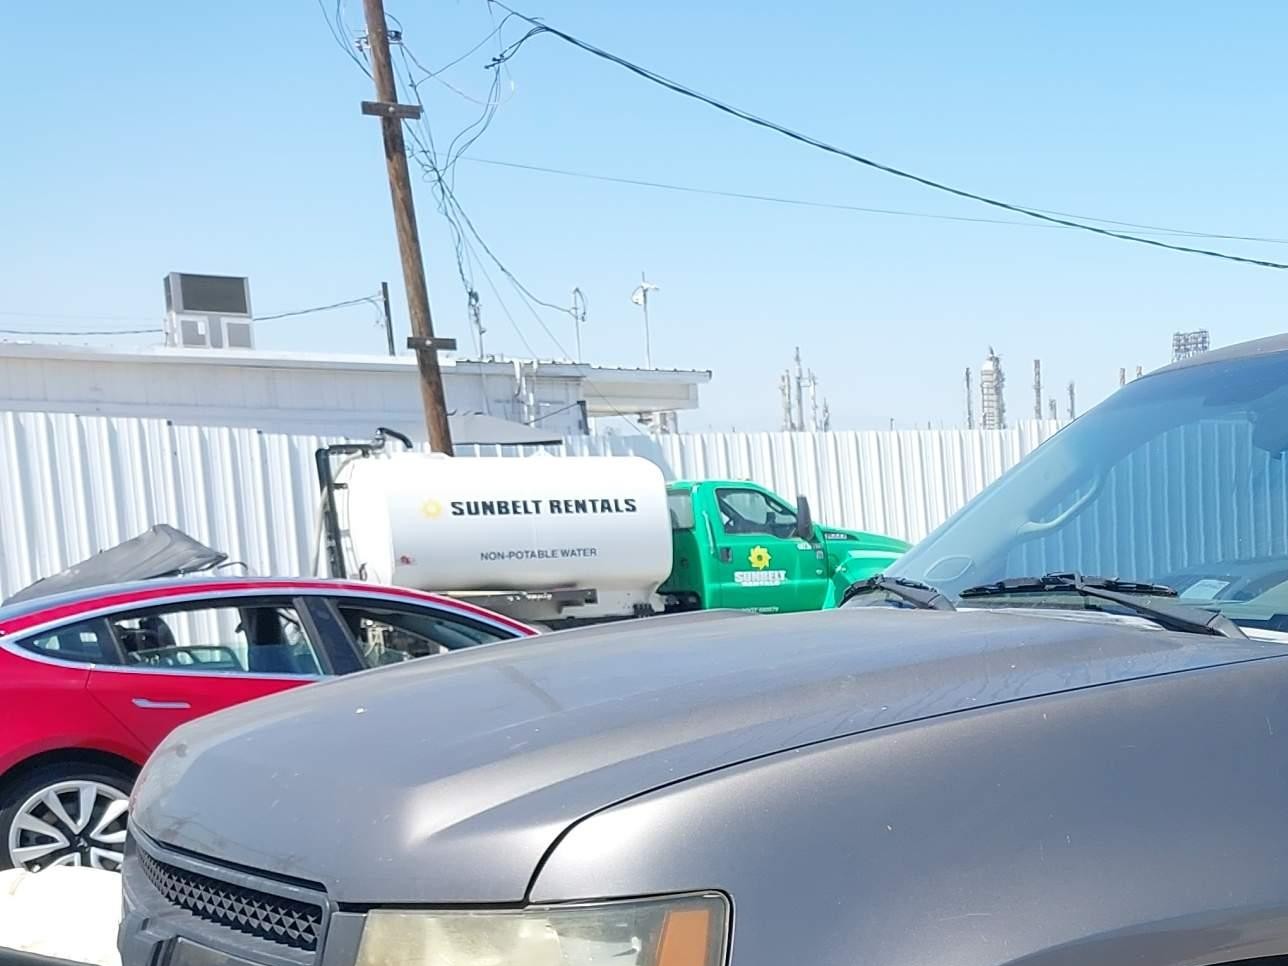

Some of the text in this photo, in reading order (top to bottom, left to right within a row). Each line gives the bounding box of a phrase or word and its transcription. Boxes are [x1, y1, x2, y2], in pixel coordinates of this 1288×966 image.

[451, 498, 637, 516] SUNBELT RENTALS
[480, 548, 597, 561] NON-POTABLE WATER
